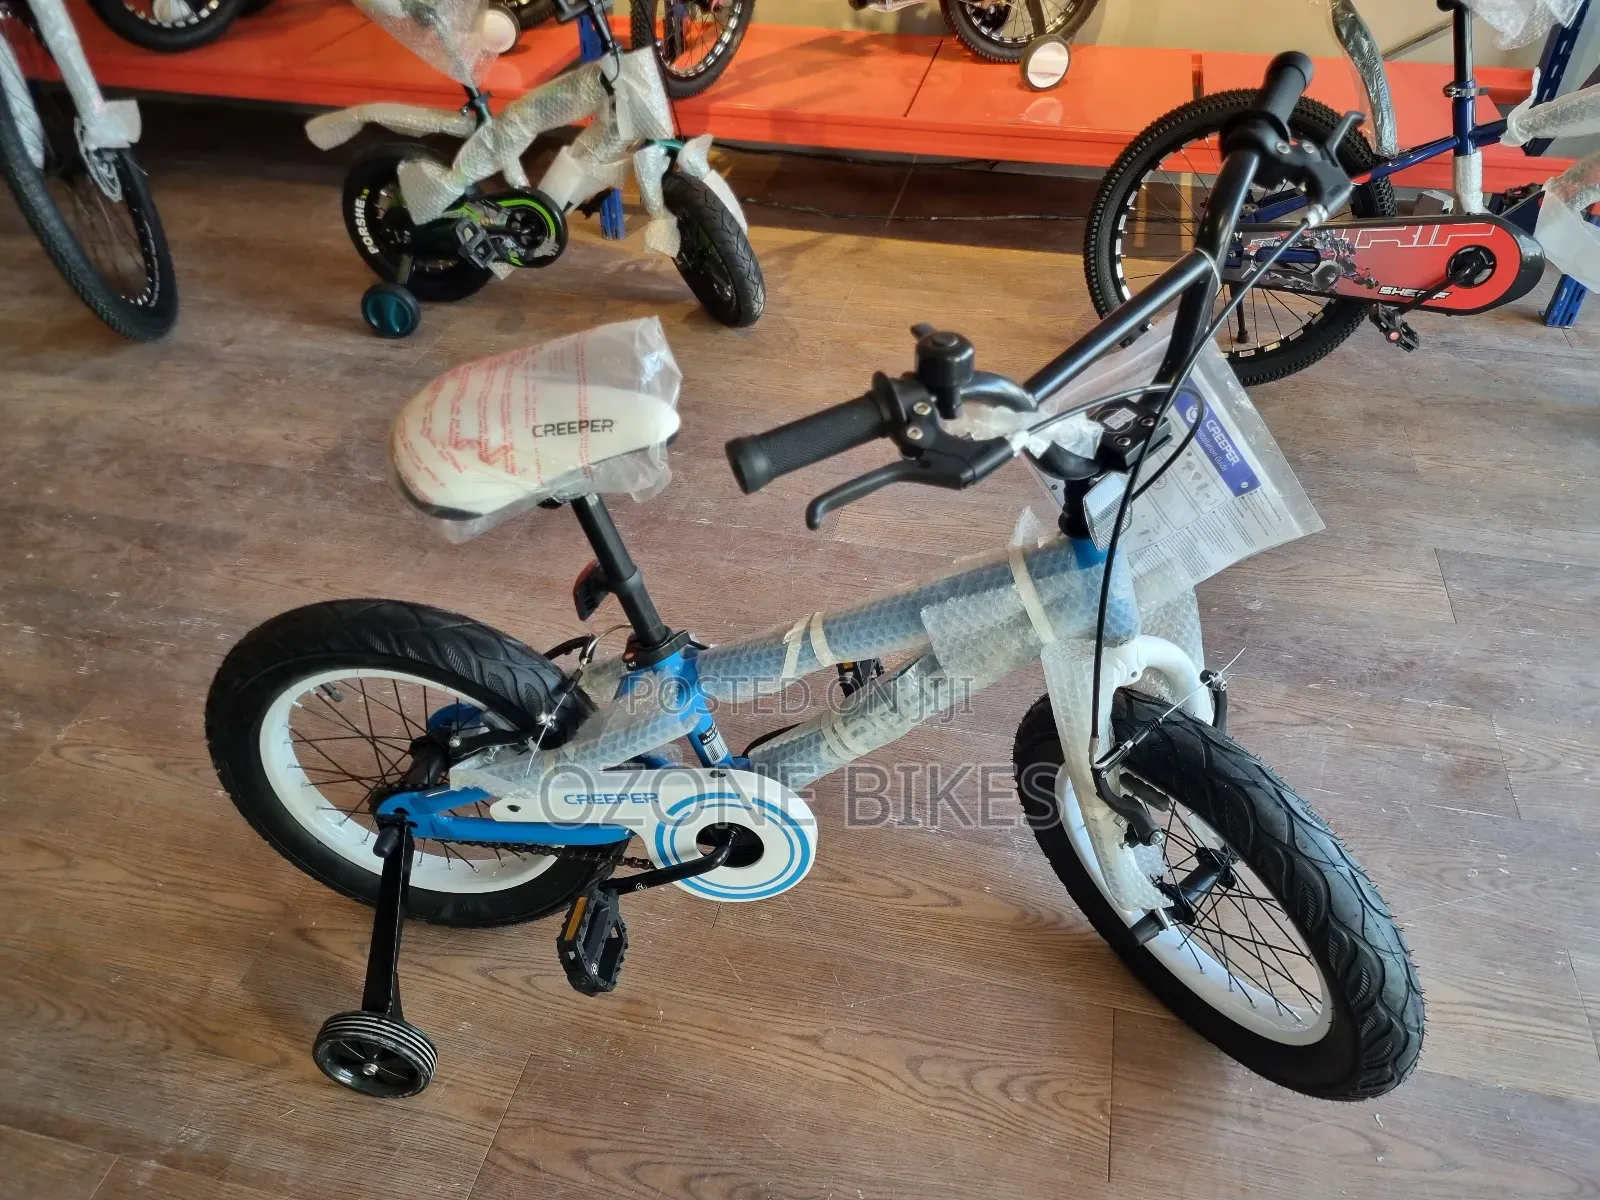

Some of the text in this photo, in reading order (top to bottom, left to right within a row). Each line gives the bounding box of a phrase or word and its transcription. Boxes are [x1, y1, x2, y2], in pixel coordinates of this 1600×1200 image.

[355, 198, 380, 255] PORSHE
[532, 418, 615, 438] CREEPER
[1205, 420, 1240, 467] CREEPER
[563, 792, 660, 805] CREEPER
